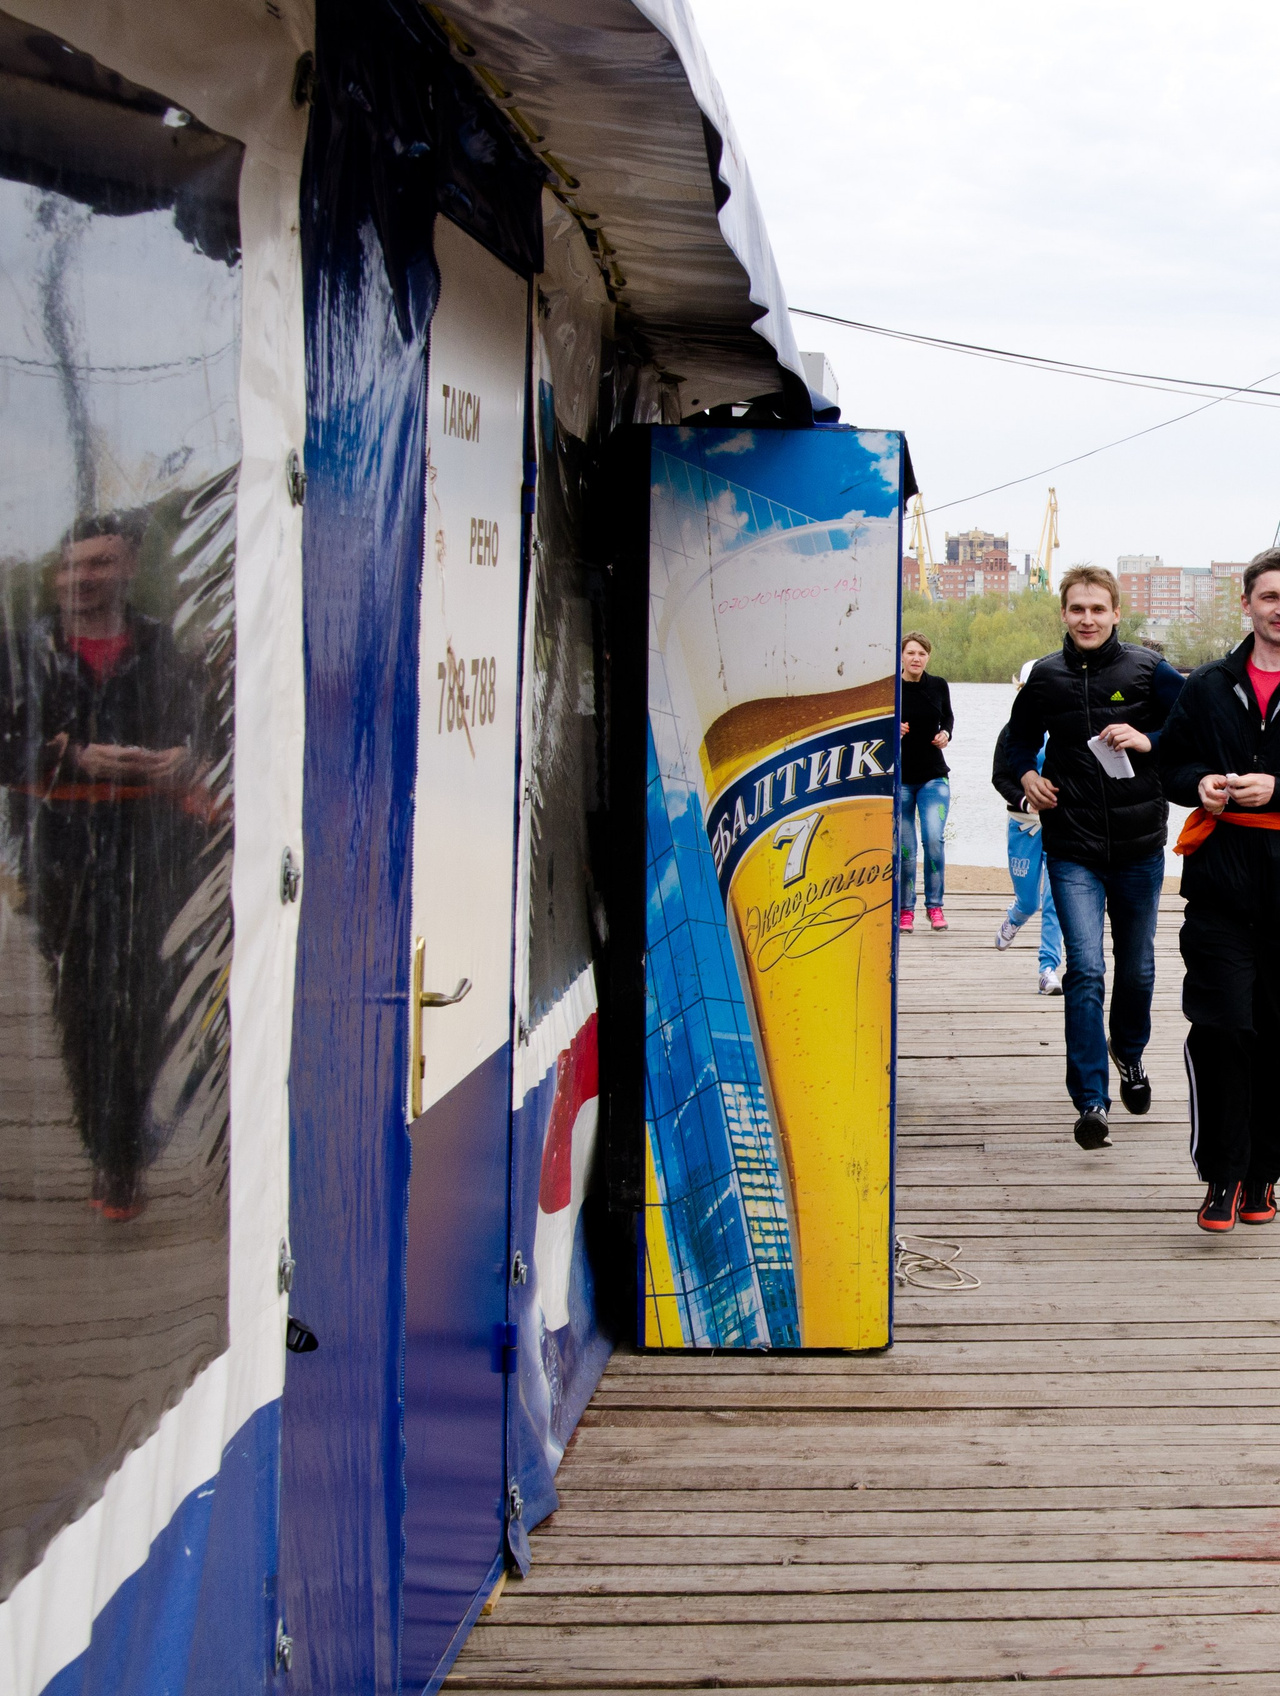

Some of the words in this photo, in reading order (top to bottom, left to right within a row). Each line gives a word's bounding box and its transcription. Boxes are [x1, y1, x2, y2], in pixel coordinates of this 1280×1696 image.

[442, 384, 481, 443] ТАКСИ
[470, 517, 499, 567] РЕНО
[438, 656, 496, 734] 788-788
[717, 738, 895, 864] БАЛТИК
[772, 811, 825, 889] 7
[744, 860, 894, 956] Экспортное
